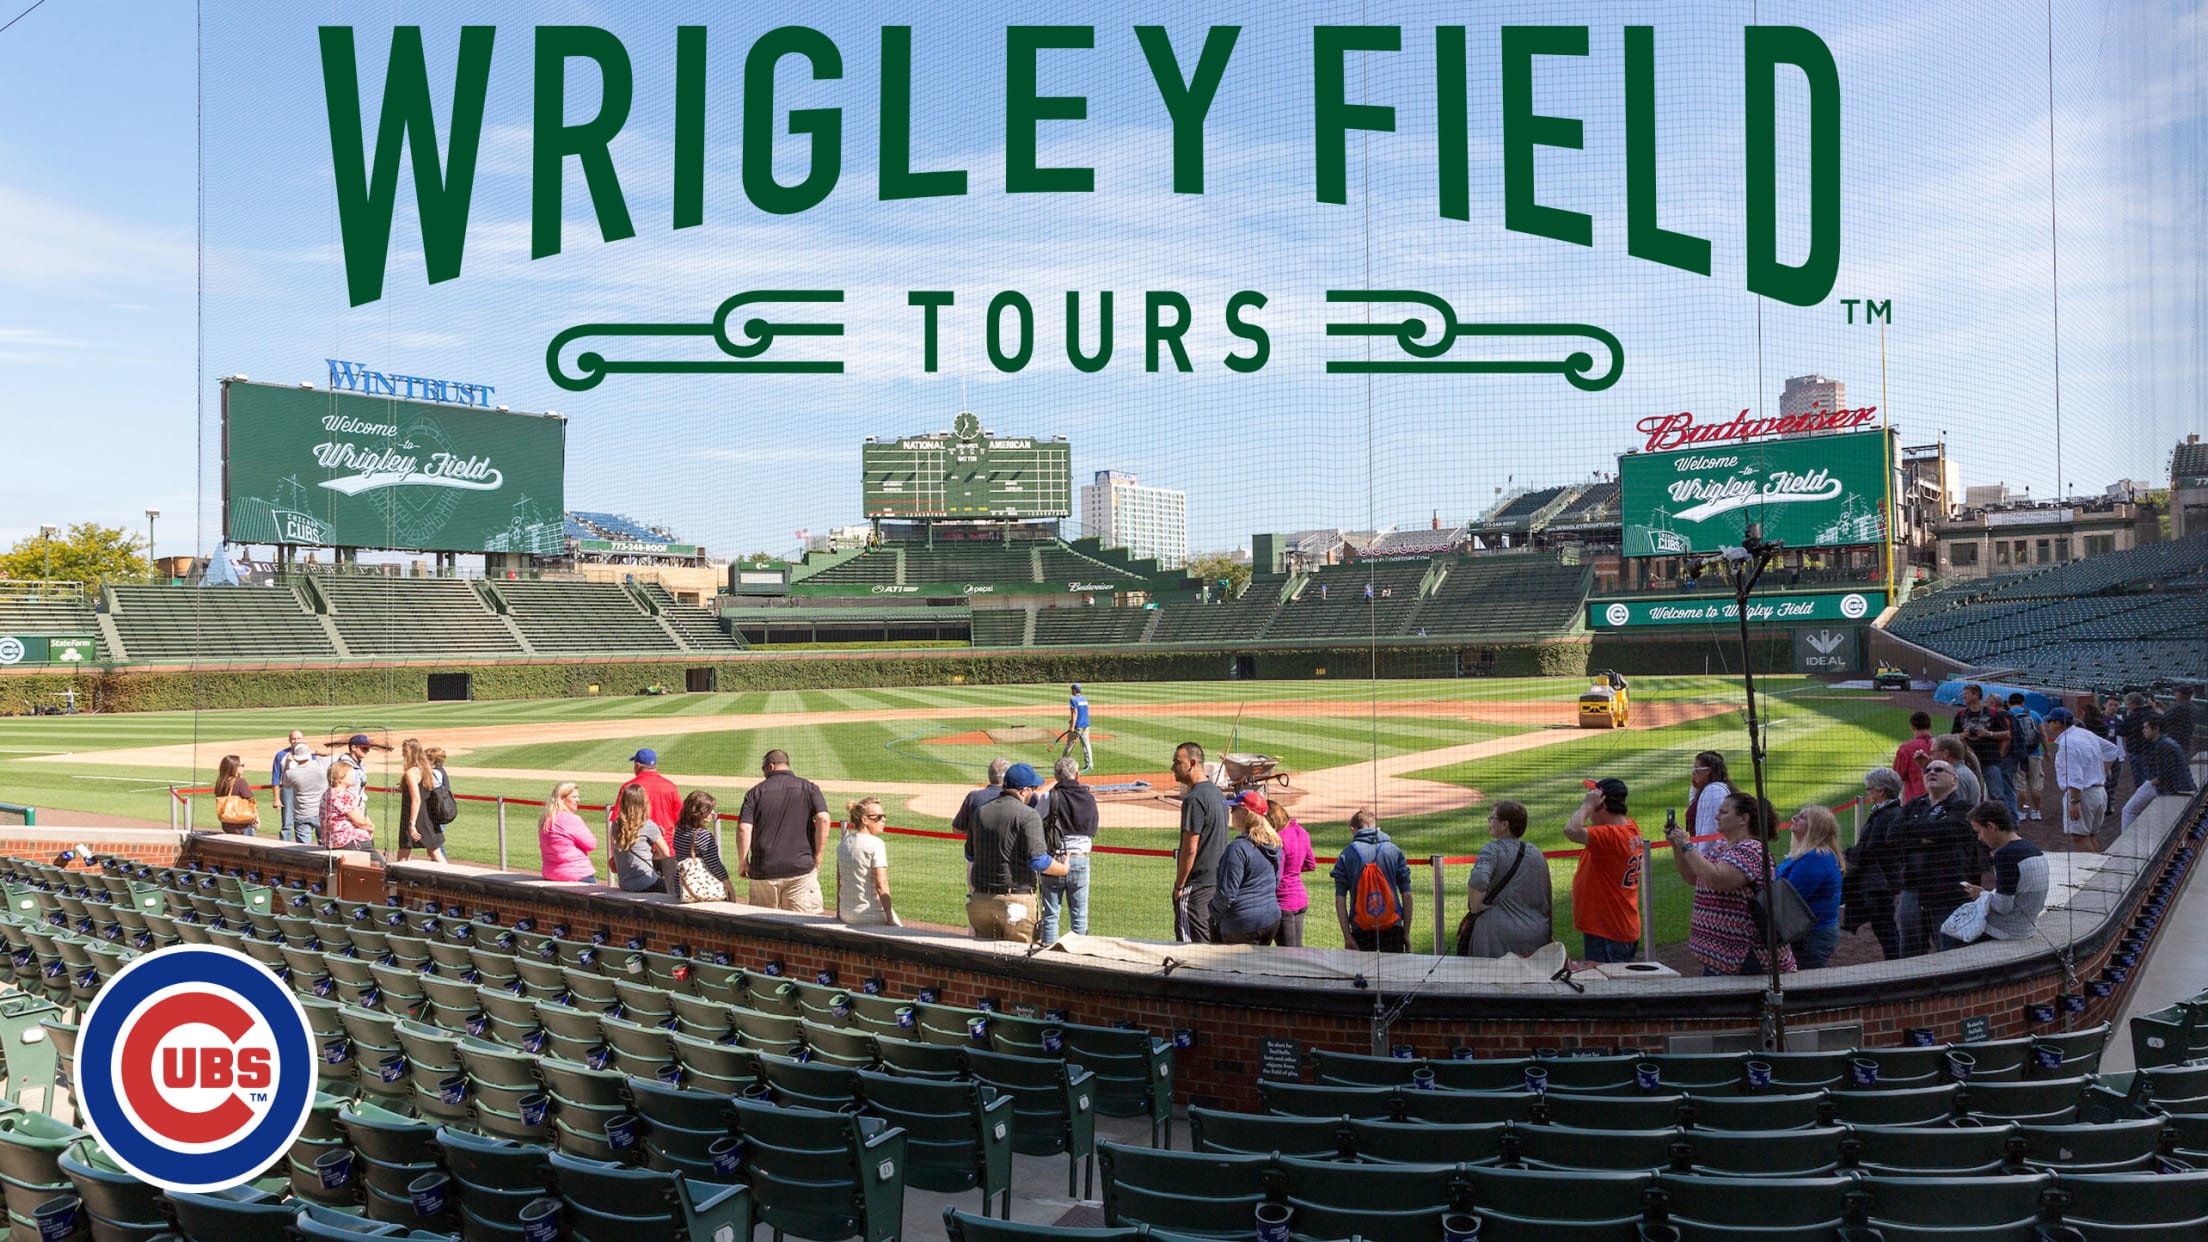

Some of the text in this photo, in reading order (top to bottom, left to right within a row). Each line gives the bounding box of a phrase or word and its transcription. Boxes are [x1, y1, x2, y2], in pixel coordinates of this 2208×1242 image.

[325, 358, 495, 408] WINTRUST
[321, 415, 398, 438] Welcome
[1636, 401, 1877, 452] Budweiser
[903, 440, 1031, 450] NATIONAL AMERICAN
[312, 441, 490, 481] Wrigley Field
[1675, 455, 1738, 472] Welcome
[1668, 468, 1830, 506] Wrigley Field
[287, 521, 320, 543] CUBS
[1658, 538, 1681, 552] CUBS
[883, 585, 903, 593] ATI
[973, 584, 994, 593] pepsi
[1068, 582, 1115, 593] Budweiser
[1649, 605, 1703, 620] Welcome
[1706, 606, 1718, 618] to
[1776, 601, 1813, 616] Field
[1805, 656, 1846, 667] IDEAL
[883, 1165, 891, 1176] D
